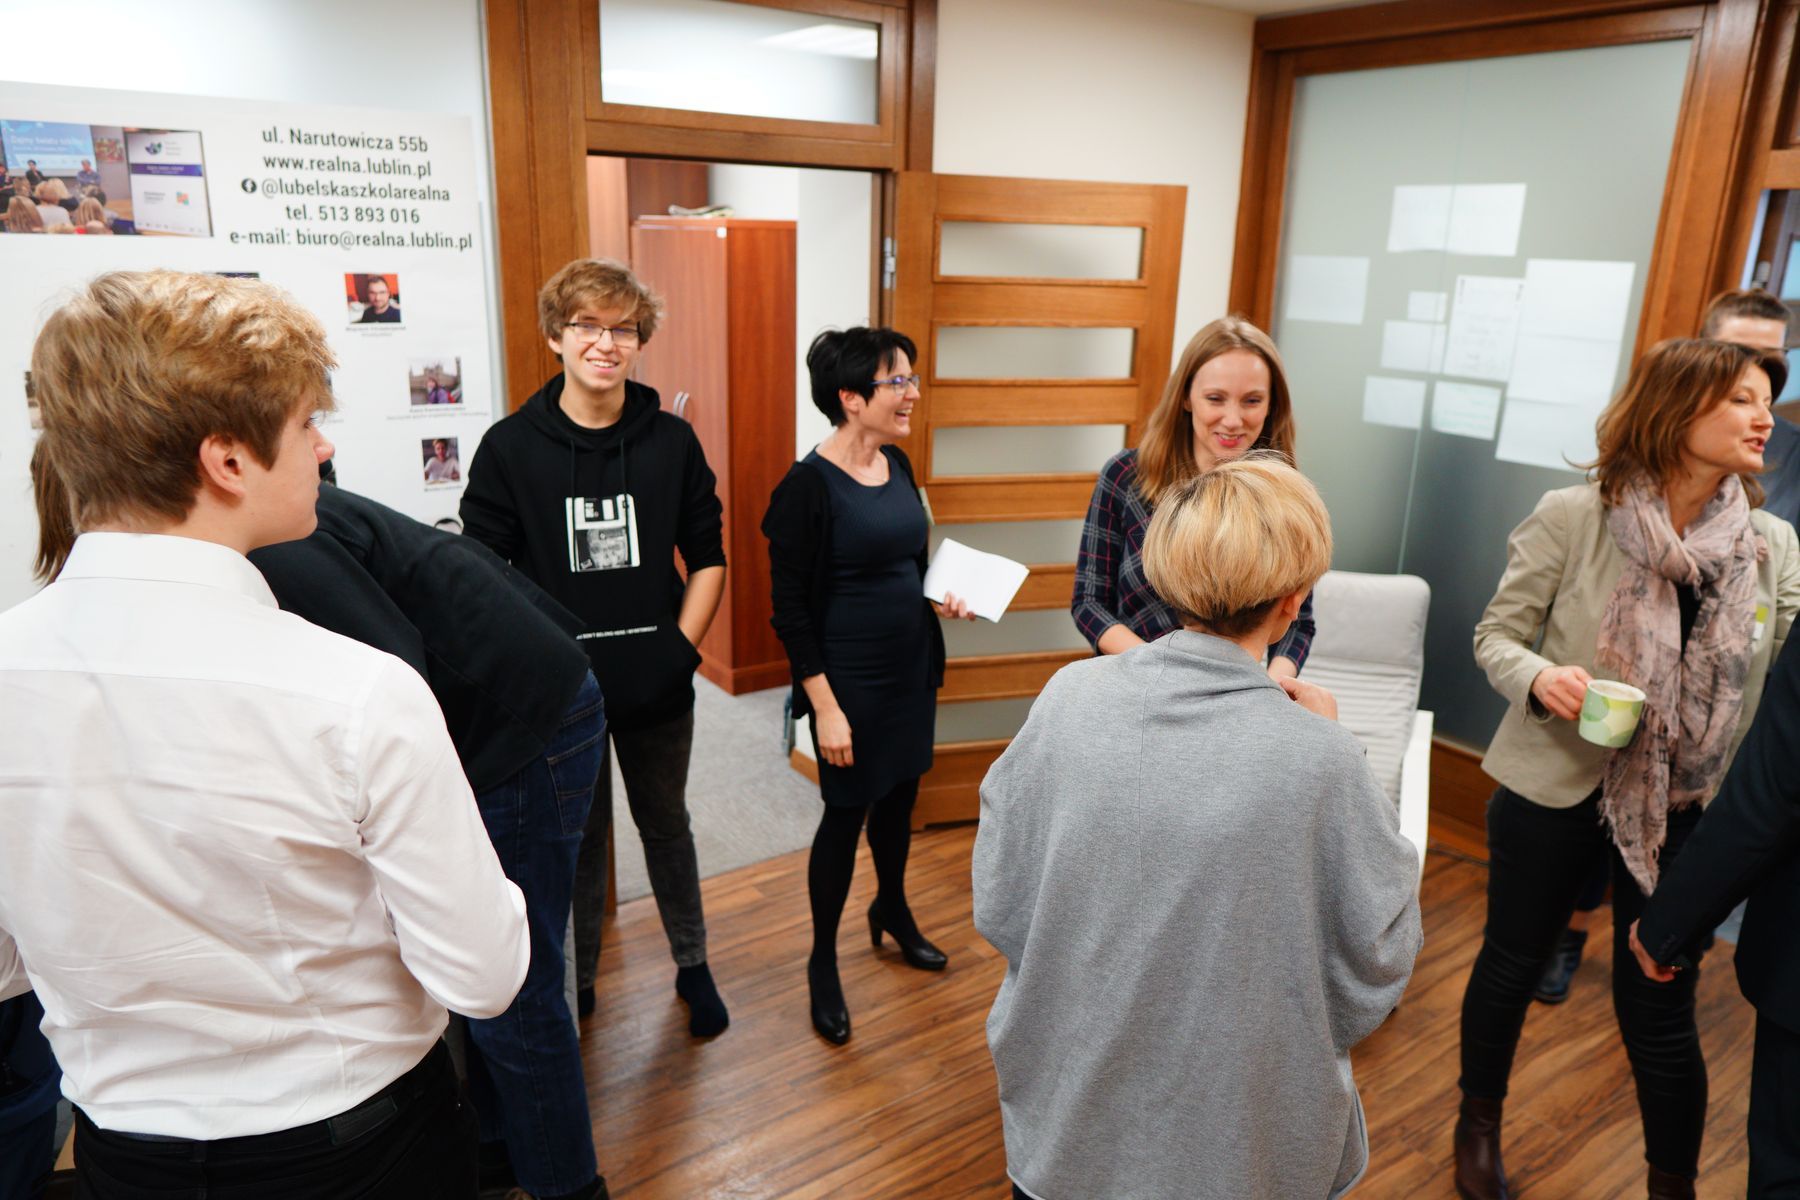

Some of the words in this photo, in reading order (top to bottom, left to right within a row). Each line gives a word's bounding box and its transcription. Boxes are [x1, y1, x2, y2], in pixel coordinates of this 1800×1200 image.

[261, 126, 284, 144] ul.
[288, 127, 394, 151] Narutowicza
[398, 135, 429, 153] 55b
[262, 154, 432, 180] www.realna.lublin.pl
[261, 176, 451, 202] @lubelskaszkolarealna
[285, 204, 313, 222] tel.
[318, 205, 350, 222] 513
[354, 206, 386, 224] 893
[389, 207, 421, 225] 016
[229, 227, 291, 246] e-mail:
[296, 228, 474, 253] biuro@realna.lublin.pl
